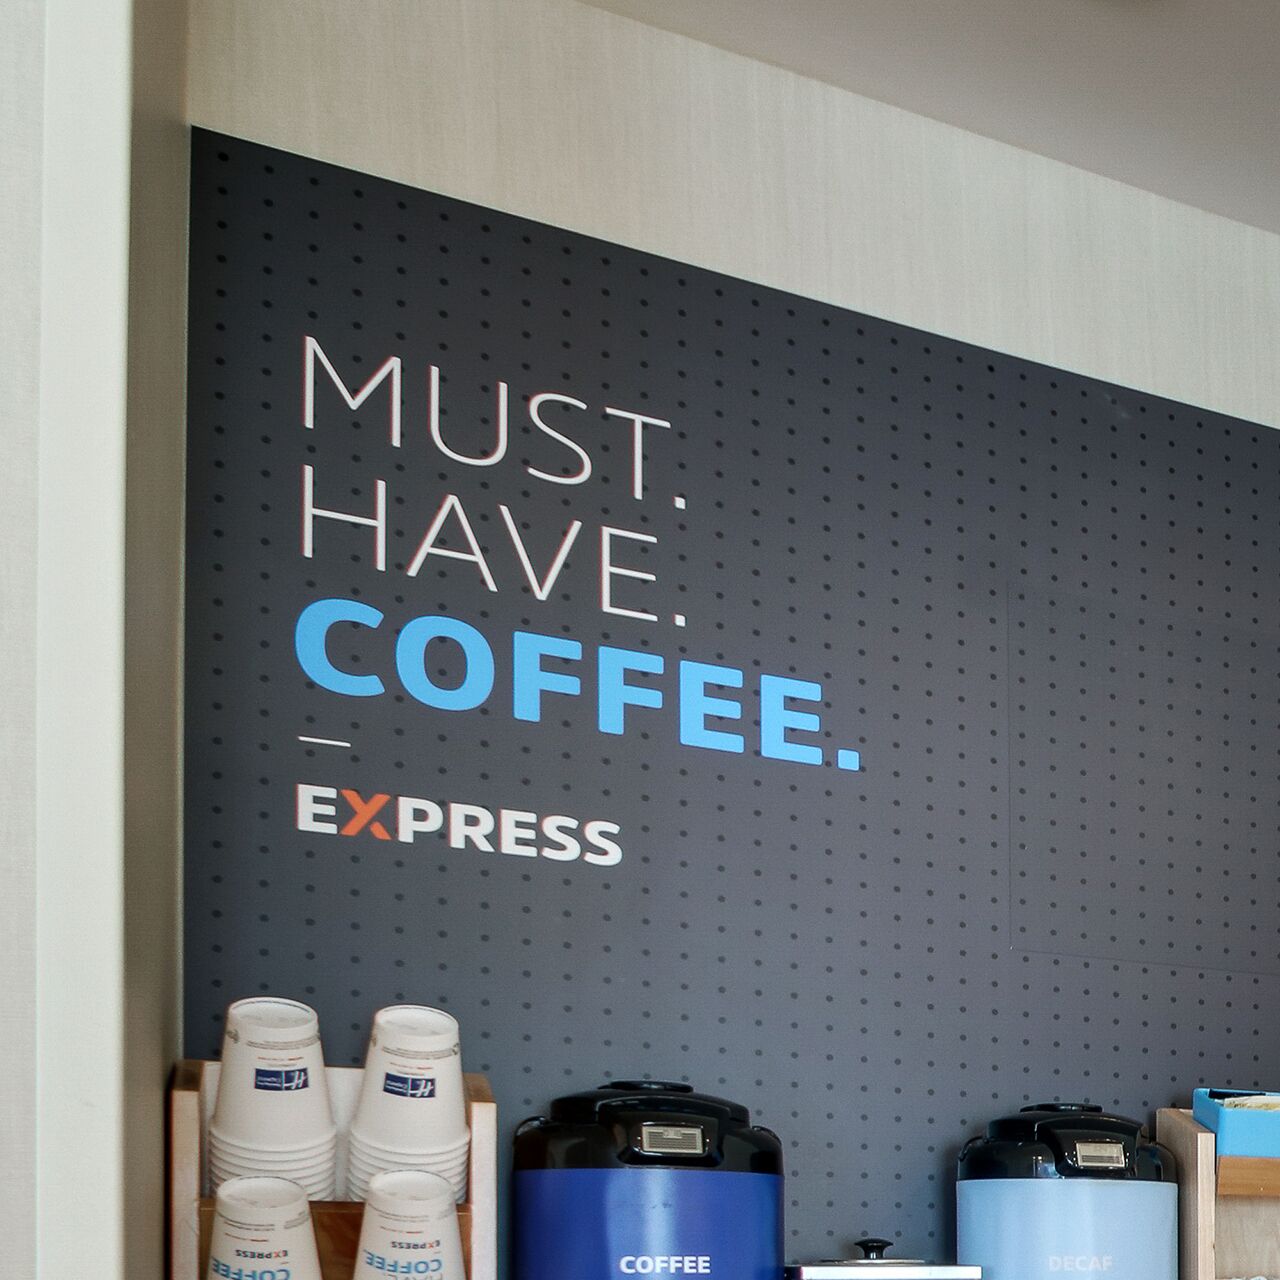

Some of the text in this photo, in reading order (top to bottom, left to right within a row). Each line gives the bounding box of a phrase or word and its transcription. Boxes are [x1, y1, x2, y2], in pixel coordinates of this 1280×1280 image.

[304, 336, 686, 509] MUST.
[303, 465, 686, 626] HAVE.
[295, 598, 860, 771] COFFEE.
[297, 784, 623, 866] EXPRESS
[235, 1249, 288, 1259] EXPRESS
[391, 1240, 440, 1250] EXPRESS
[619, 1255, 711, 1274] COFFEE
[1049, 1255, 1113, 1271] DECAF
